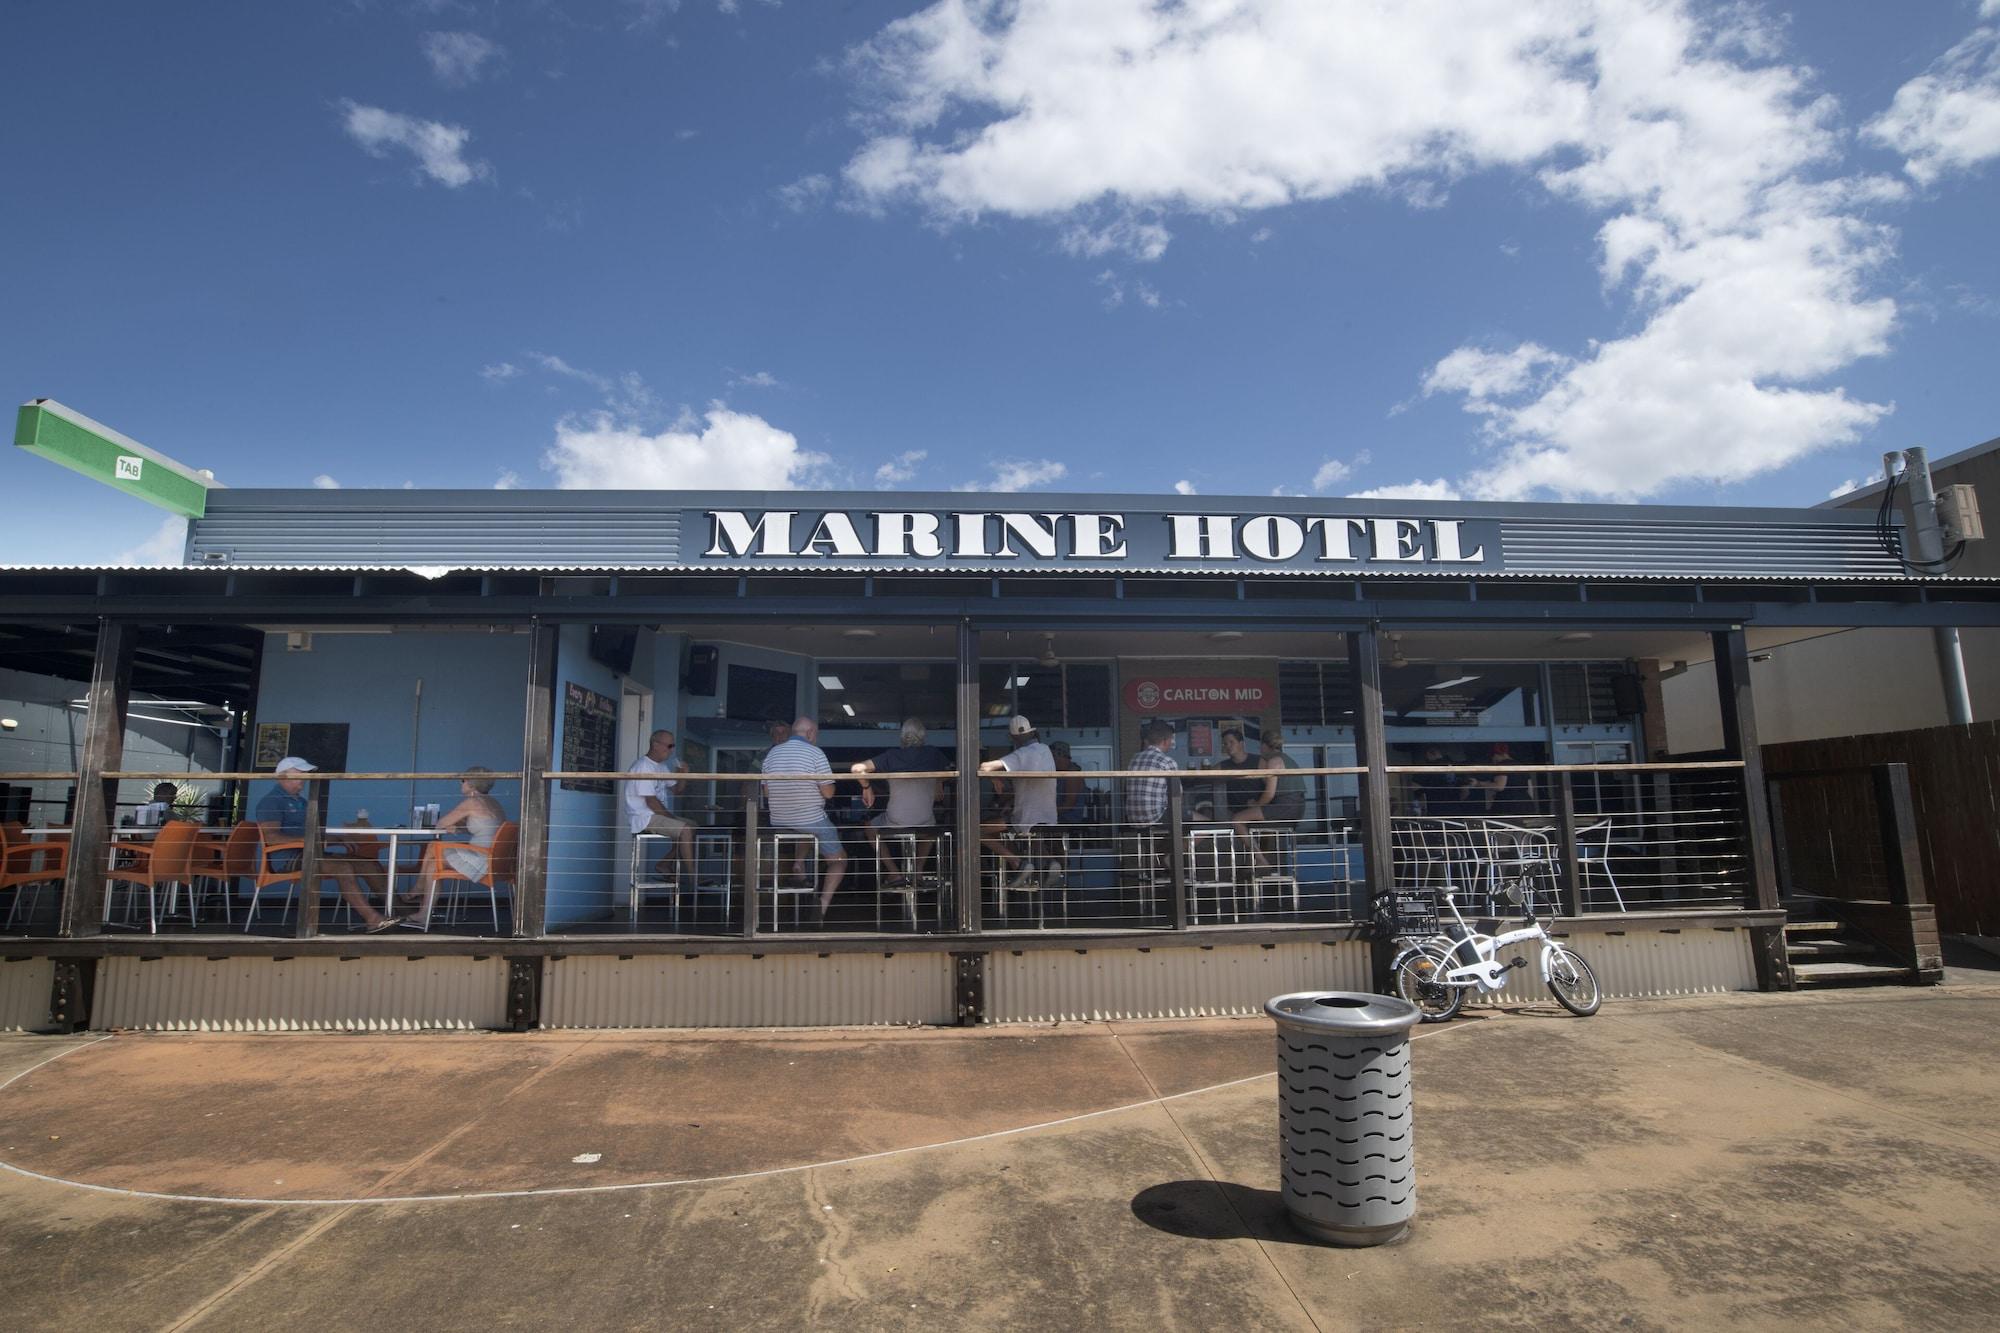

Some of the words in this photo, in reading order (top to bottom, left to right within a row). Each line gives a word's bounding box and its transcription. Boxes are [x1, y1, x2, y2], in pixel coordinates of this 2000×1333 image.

[120, 459, 139, 477] TAB
[702, 511, 1128, 558] MARINE
[1164, 514, 1485, 562] HOTEL
[1163, 688, 1230, 701] CARLTON
[1234, 688, 1263, 701] MID
